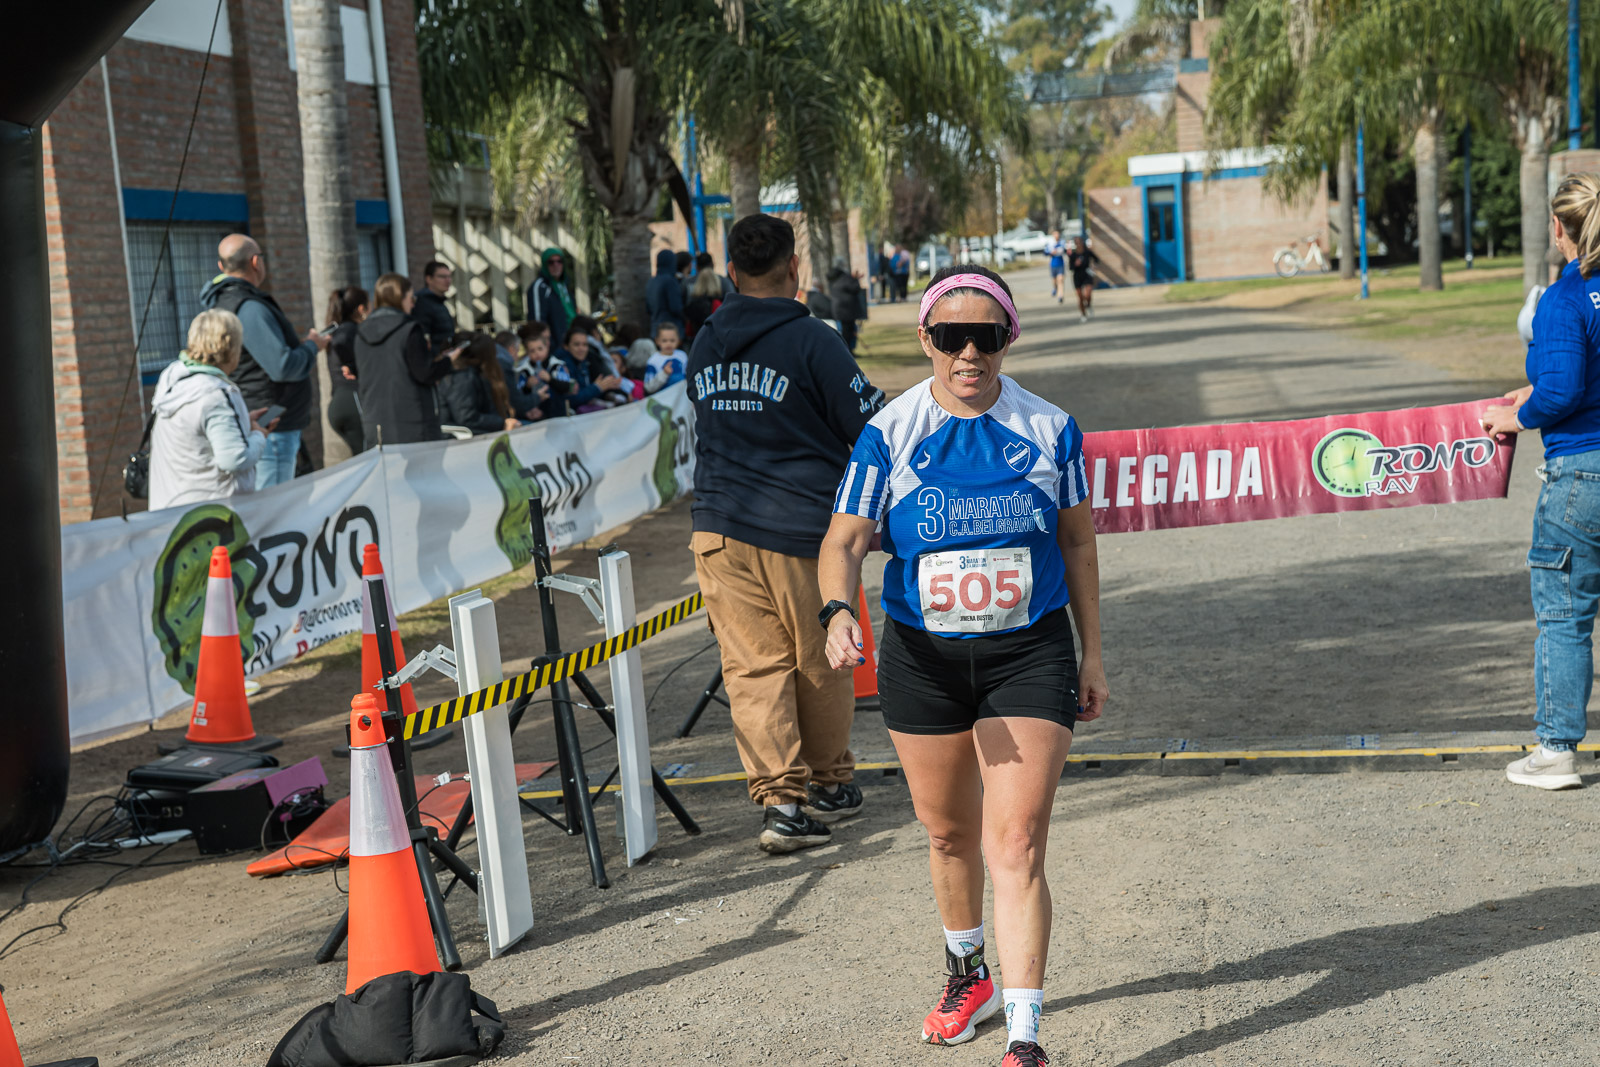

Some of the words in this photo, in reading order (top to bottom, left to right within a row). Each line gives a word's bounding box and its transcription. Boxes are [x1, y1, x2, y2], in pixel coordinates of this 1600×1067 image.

[694, 362, 790, 403] BELGRANO
[712, 399, 763, 412] AREQUITO
[1092, 446, 1264, 509] LEGADA
[1365, 476, 1419, 497] RAV
[917, 486, 946, 542] 3
[948, 490, 1035, 521] MARATÓN
[929, 569, 1022, 613] 505
